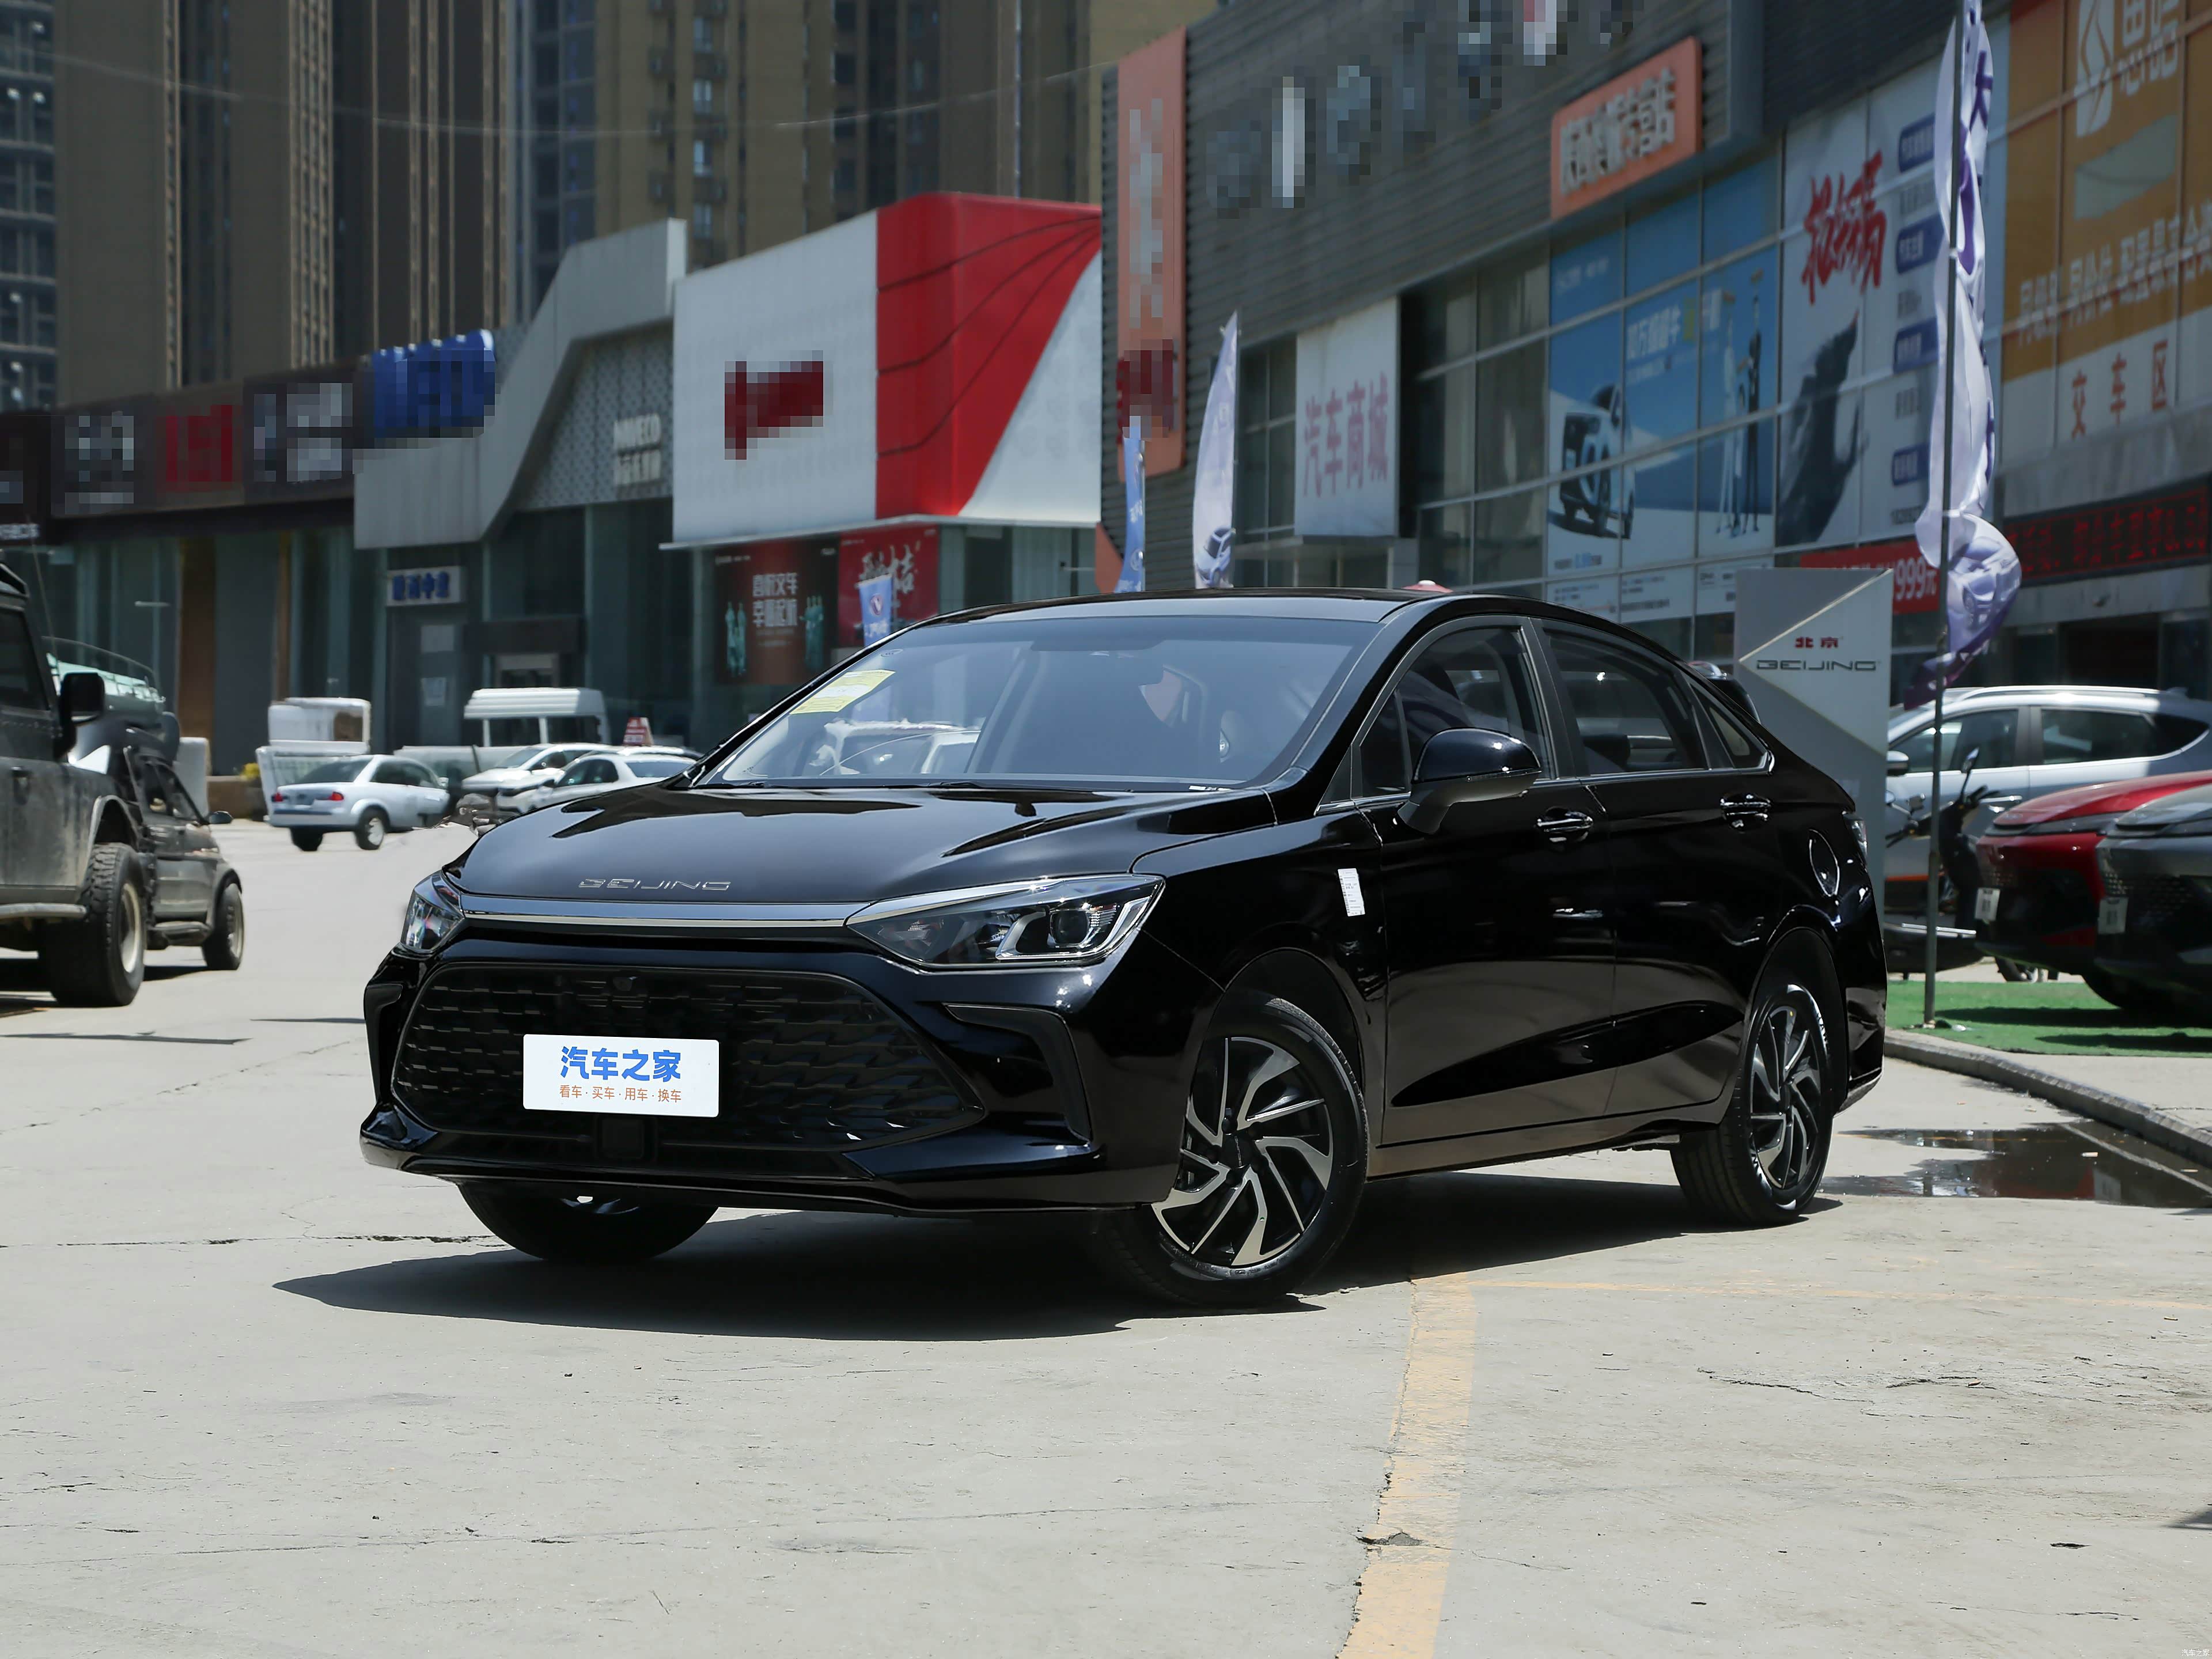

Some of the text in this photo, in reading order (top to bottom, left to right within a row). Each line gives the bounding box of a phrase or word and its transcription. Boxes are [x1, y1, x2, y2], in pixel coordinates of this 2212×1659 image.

[2071, 339, 2168, 440] 交车区
[1303, 372, 1388, 498] 汽车商城
[1795, 637, 1839, 649] 北京
[1756, 660, 1876, 671] BEIJING
[578, 878, 731, 891] BEIJING
[560, 1046, 681, 1082] 汽车之家
